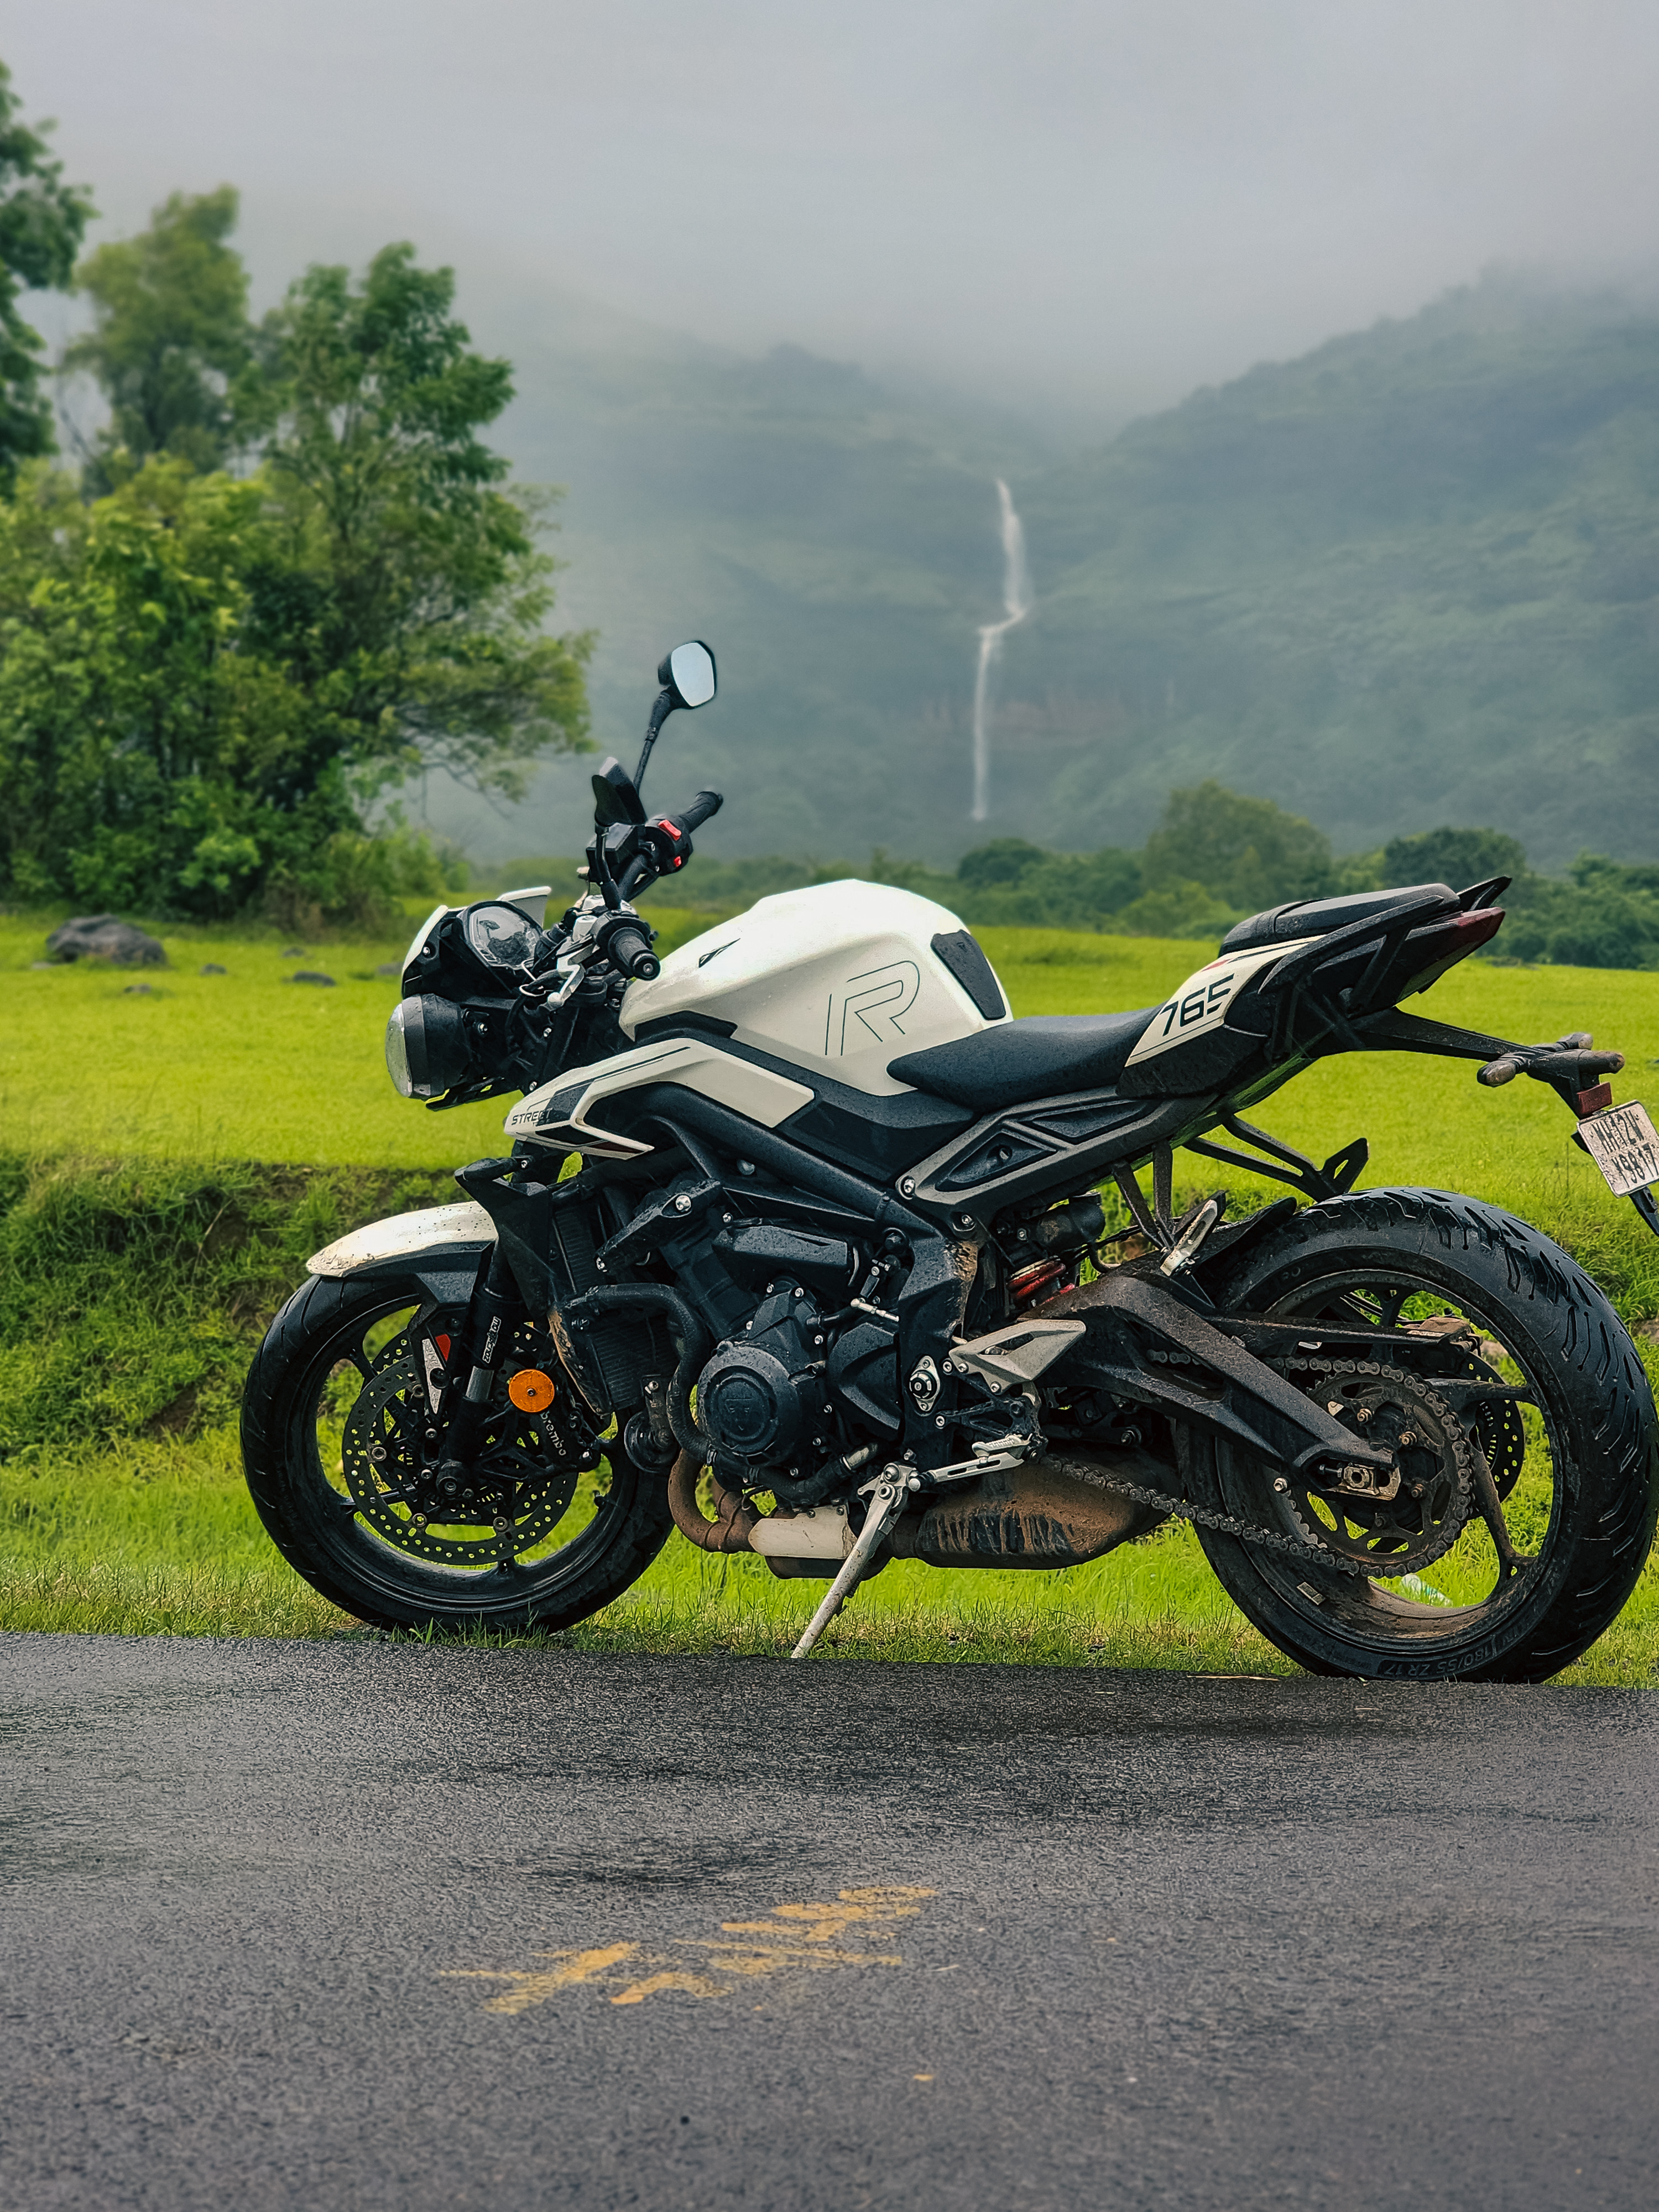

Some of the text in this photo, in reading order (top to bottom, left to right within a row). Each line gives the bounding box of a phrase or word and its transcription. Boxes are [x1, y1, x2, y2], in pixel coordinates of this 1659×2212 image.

[825, 961, 920, 1056] R
[1160, 973, 1235, 1037] 765
[512, 1107, 553, 1125] STREET
[540, 1410, 566, 1455] brembo
